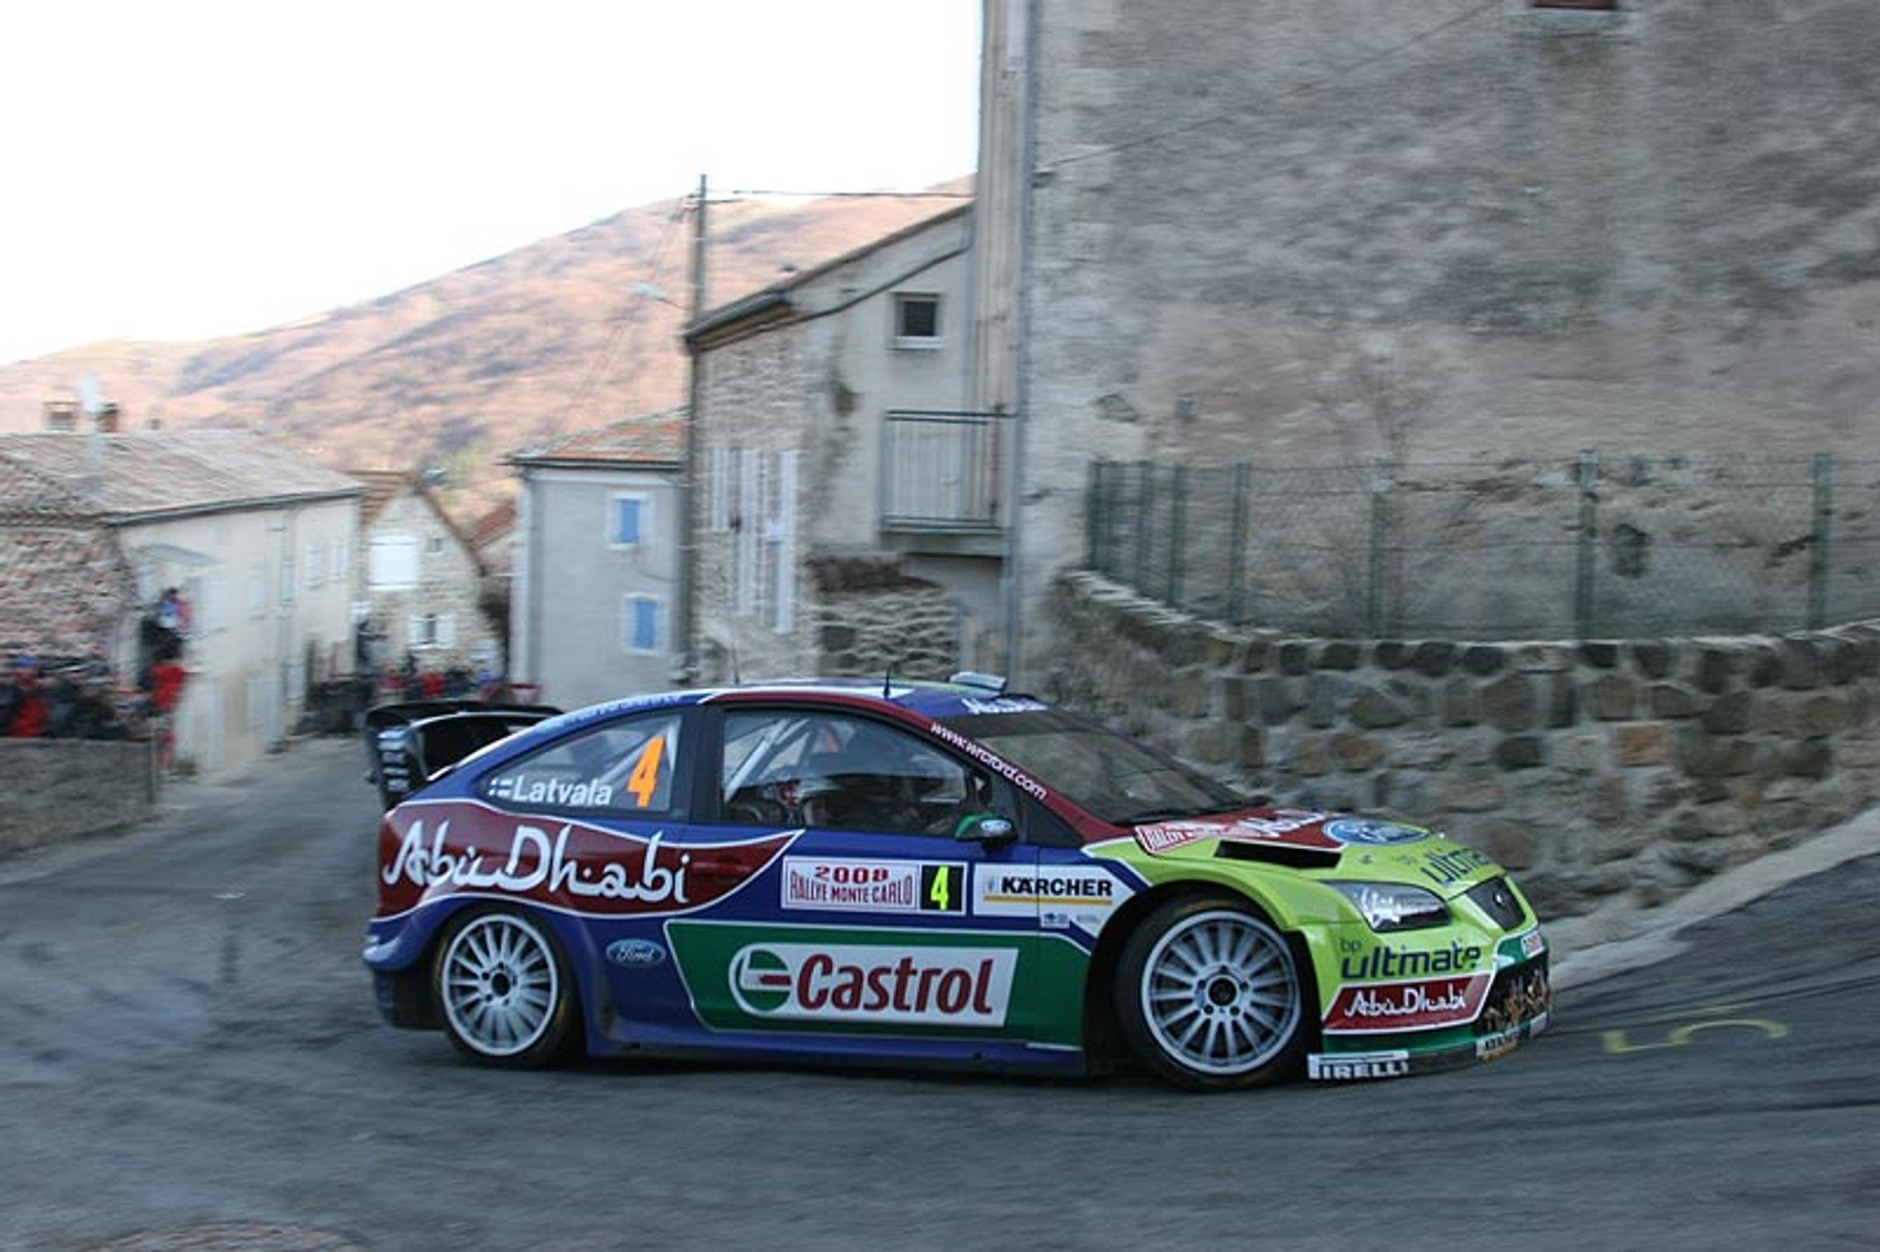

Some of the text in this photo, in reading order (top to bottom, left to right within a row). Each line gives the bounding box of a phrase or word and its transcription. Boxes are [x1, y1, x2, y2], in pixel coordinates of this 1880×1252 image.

[627, 736, 664, 807] 4
[512, 775, 613, 806] Latvala
[790, 869, 827, 901] RALLYE
[814, 865, 889, 884] 2008
[930, 865, 949, 911] 4
[1001, 875, 1113, 897] KÄRCHER
[797, 953, 993, 1015] Castrol
